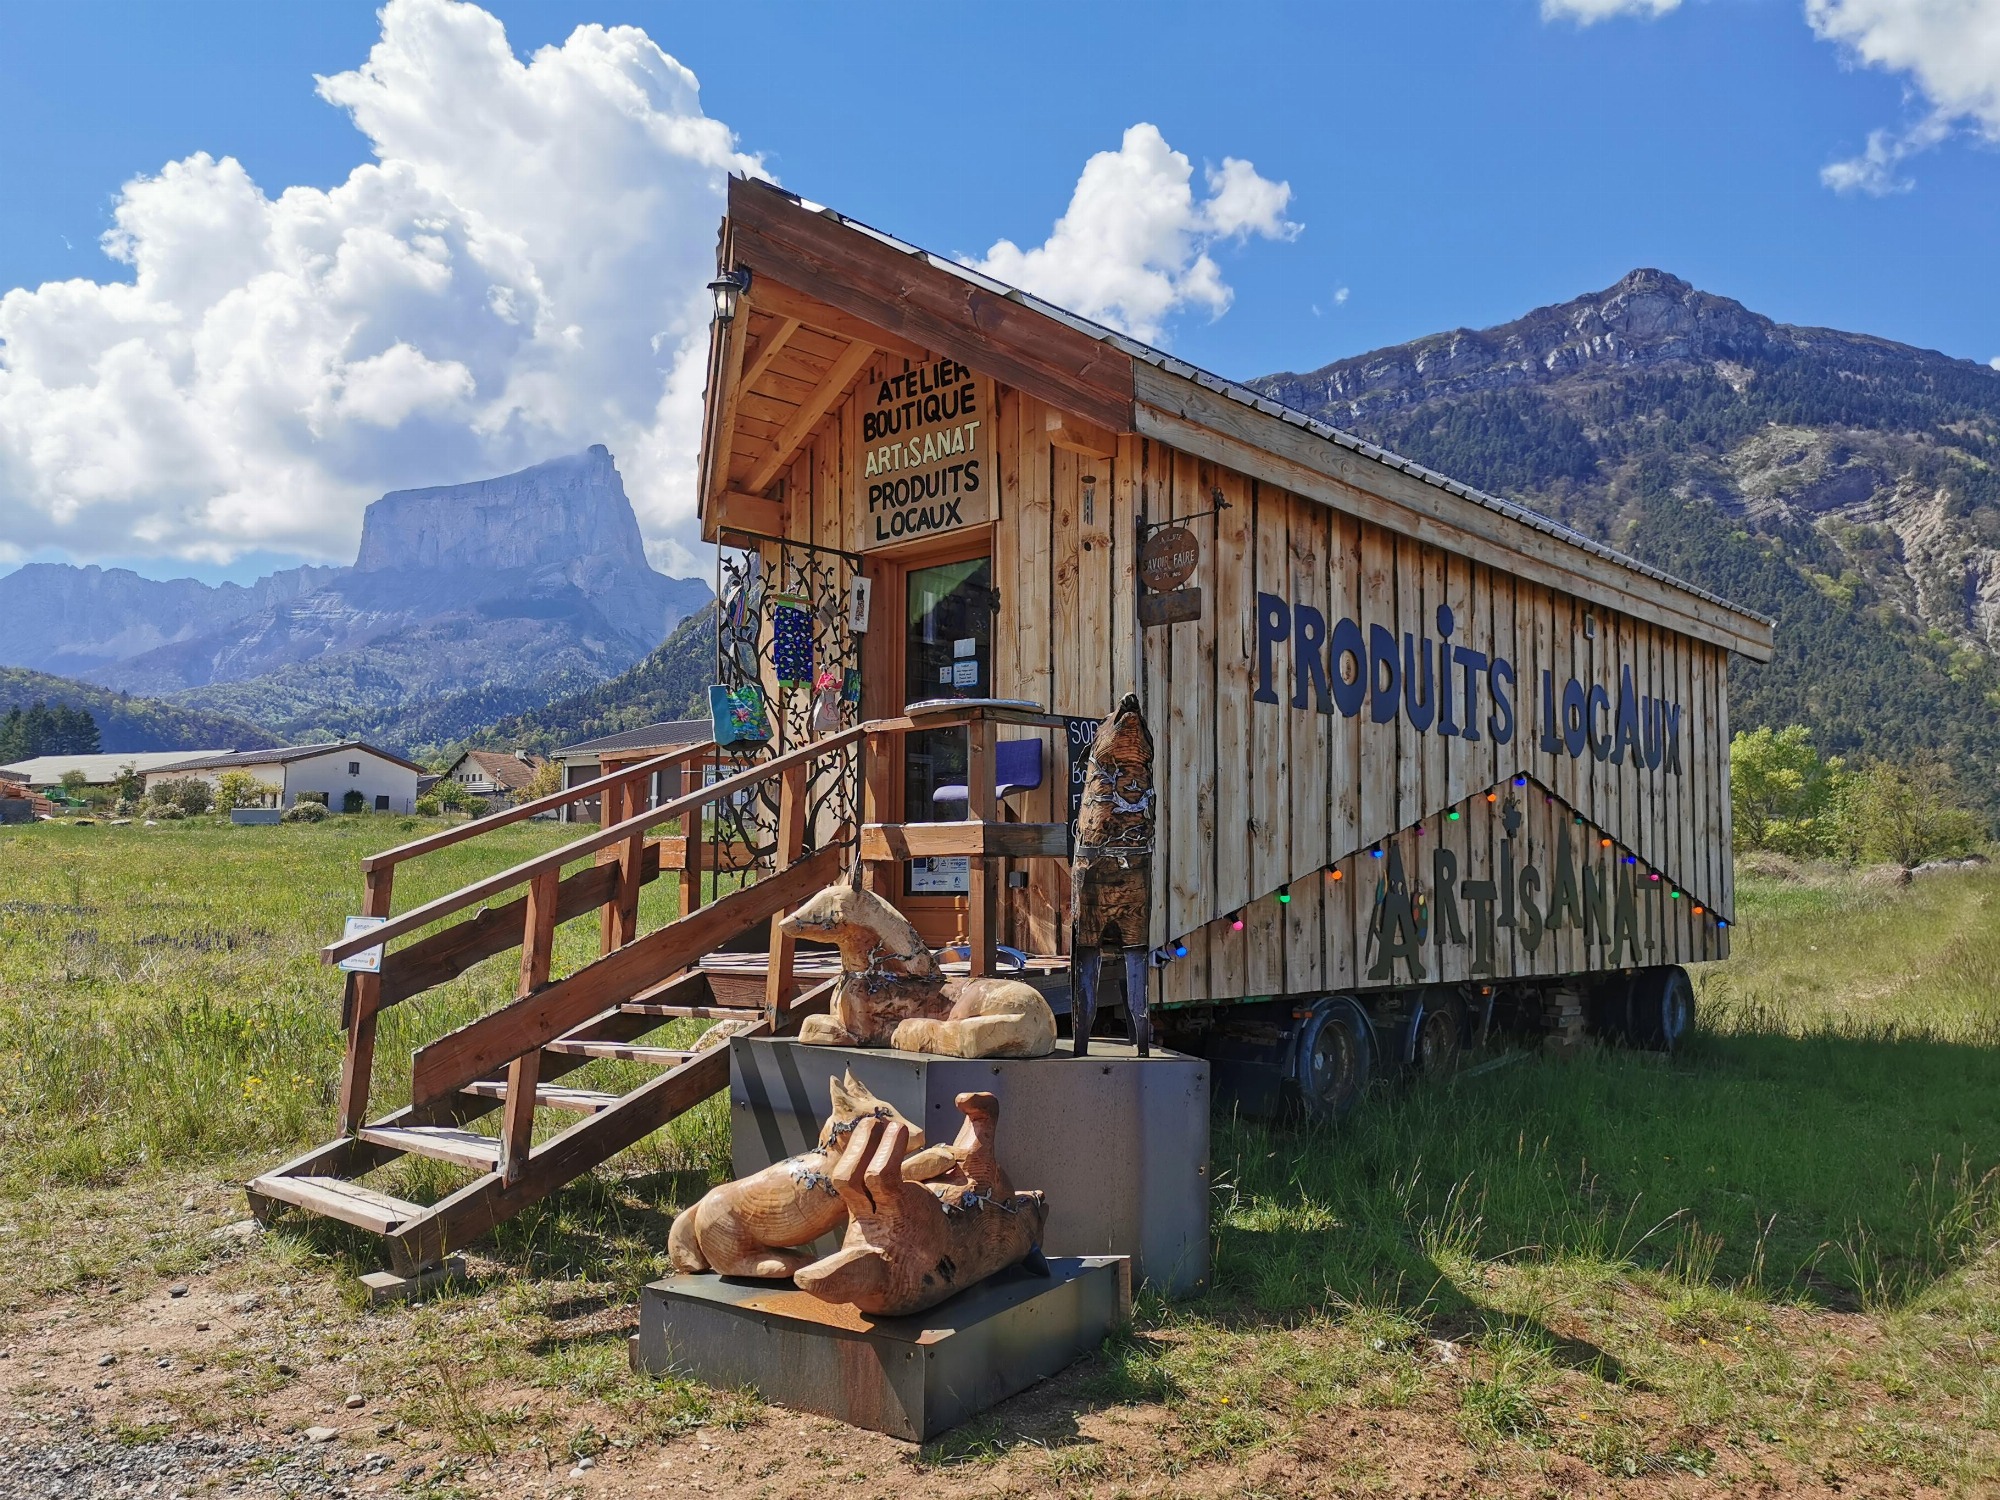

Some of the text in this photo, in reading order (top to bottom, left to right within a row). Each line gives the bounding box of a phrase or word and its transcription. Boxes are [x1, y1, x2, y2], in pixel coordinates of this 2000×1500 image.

[863, 382, 977, 443] BOUTIQUE
[869, 460, 980, 513] PRODUITS
[876, 497, 963, 541] LOCAUX
[1540, 664, 1683, 776] LOCAUX
